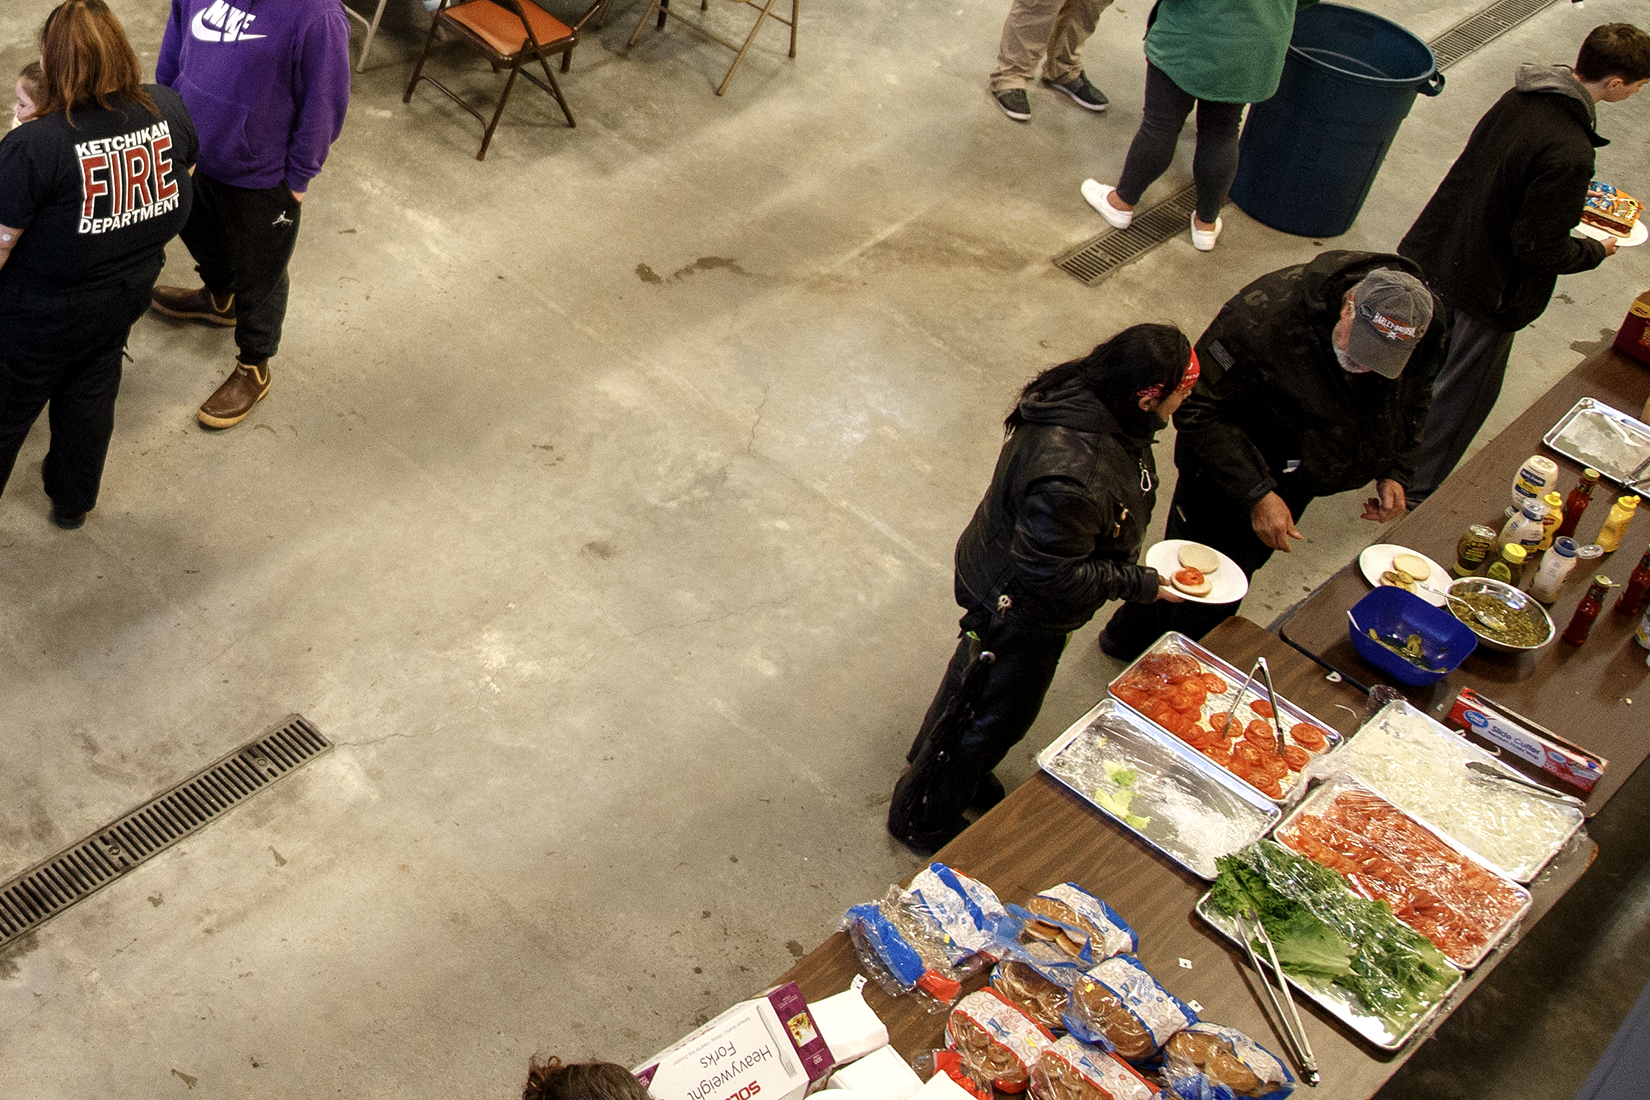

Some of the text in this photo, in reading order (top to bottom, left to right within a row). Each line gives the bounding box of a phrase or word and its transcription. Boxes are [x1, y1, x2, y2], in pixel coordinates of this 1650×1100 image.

[75, 120, 170, 157] KETCHIKAN
[79, 134, 179, 219] FIRE
[78, 193, 180, 234] DEPARTMENT
[1491, 725, 1541, 756] Slide Cutter
[686, 1044, 773, 1100] Heavyweight
[699, 1041, 738, 1069] Forks
[724, 1080, 762, 1100] SOL
